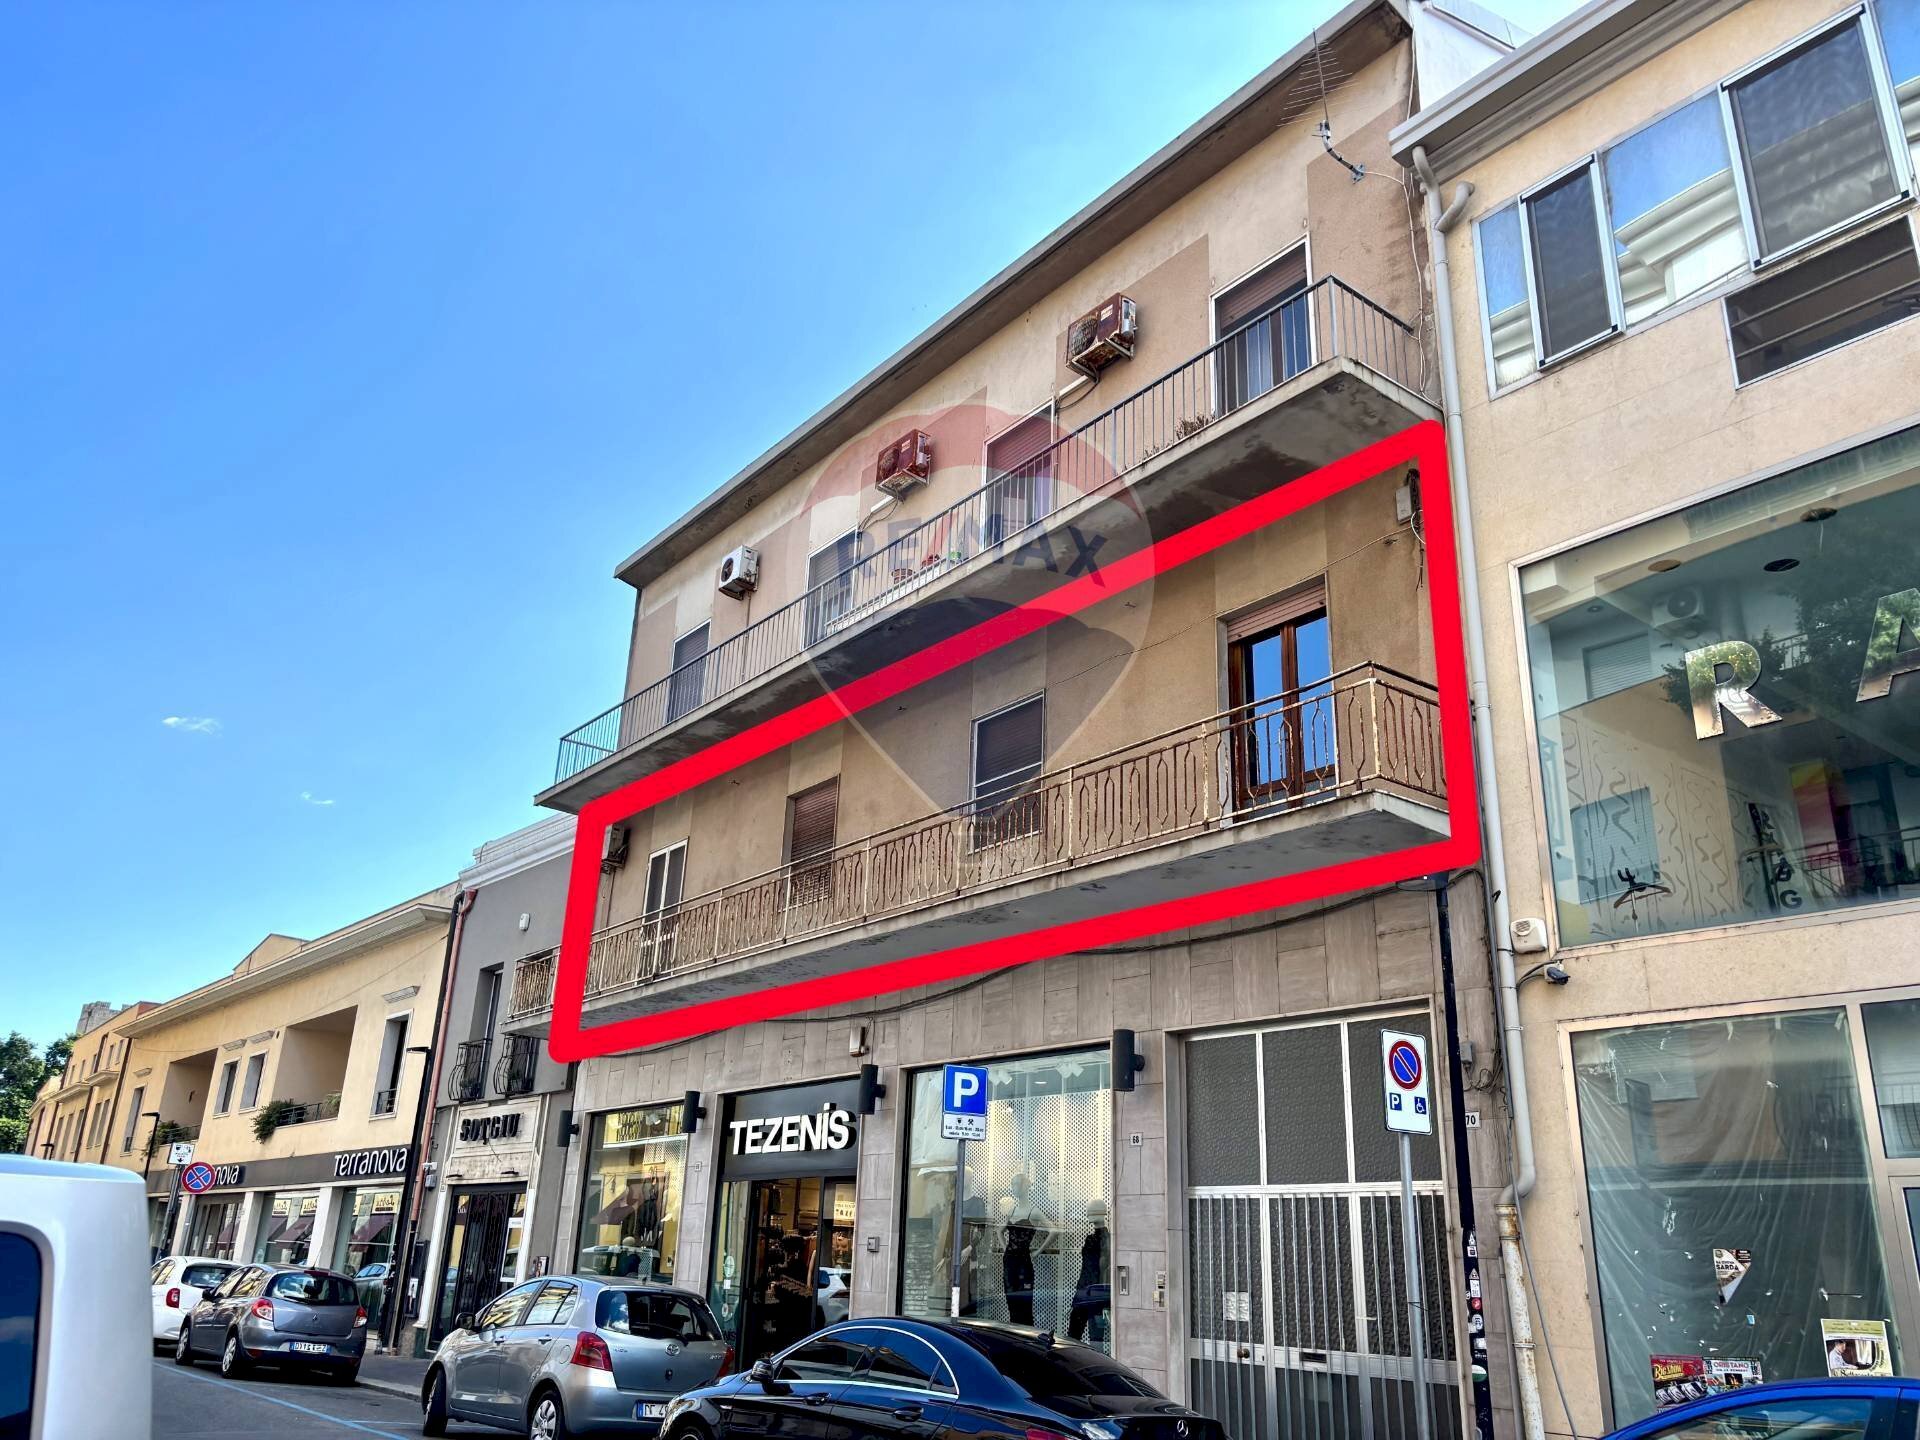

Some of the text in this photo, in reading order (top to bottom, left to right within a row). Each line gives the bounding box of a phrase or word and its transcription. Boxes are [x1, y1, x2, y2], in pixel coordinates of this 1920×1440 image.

[953, 1071, 980, 1108] P
[729, 1102, 852, 1155] TEZENIS
[334, 1147, 408, 1177] Terranova
